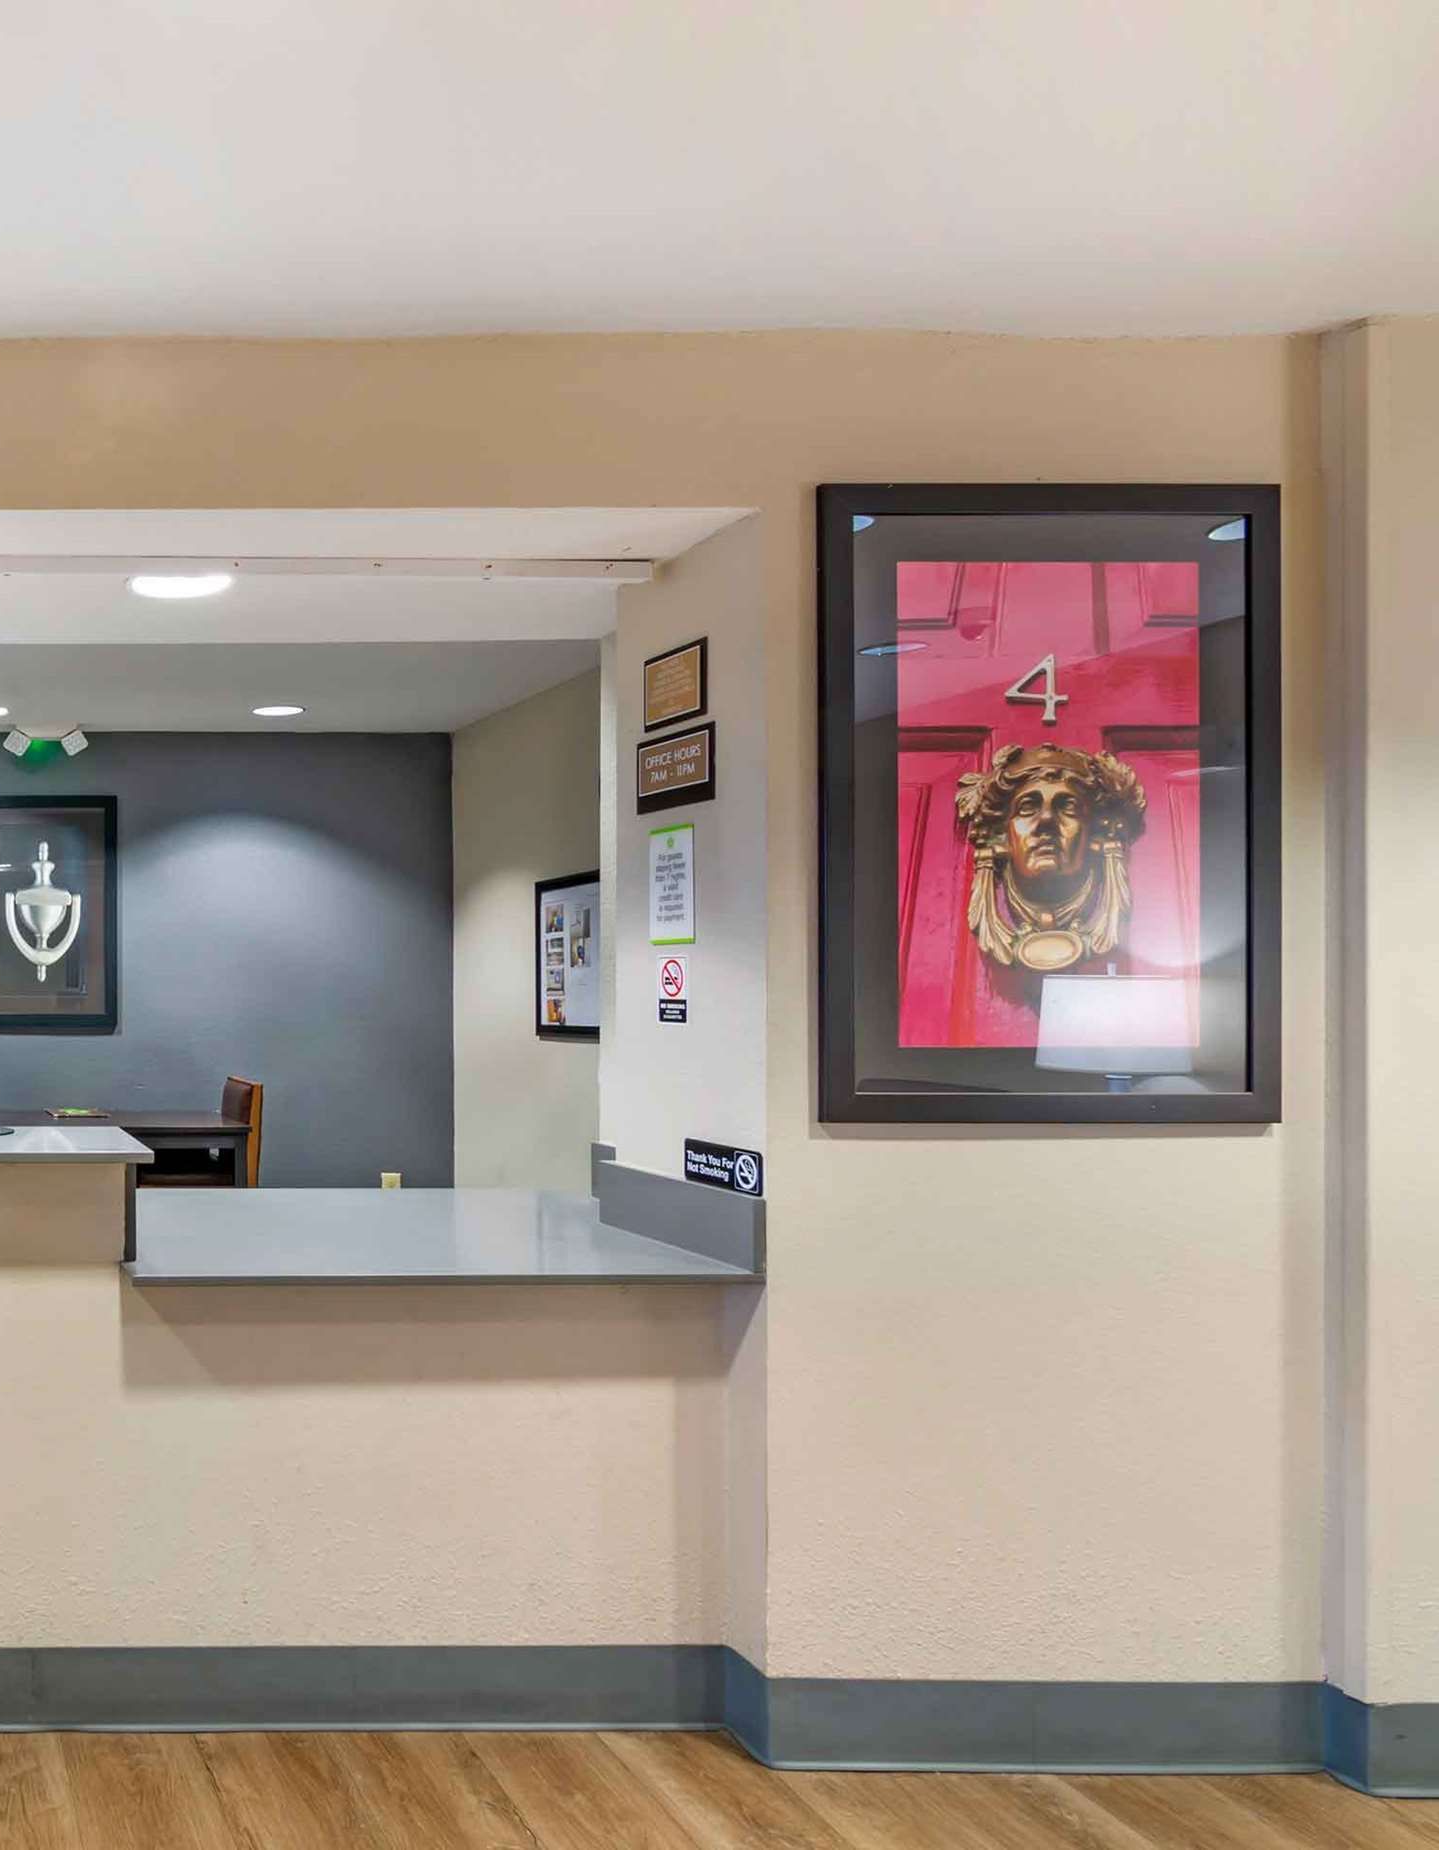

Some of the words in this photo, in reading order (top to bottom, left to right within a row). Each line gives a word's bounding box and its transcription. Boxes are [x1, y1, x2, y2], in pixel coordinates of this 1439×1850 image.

[1004, 654, 1069, 724] 4
[645, 751, 673, 770] OFFICE
[673, 743, 702, 762] HOURS
[649, 769, 668, 784] 7AM
[687, 1151, 707, 1164] Thank
[708, 1154, 721, 1166] You
[722, 1158, 734, 1168] For
[687, 1161, 698, 1172] Not
[700, 1165, 728, 1182] Smoking
